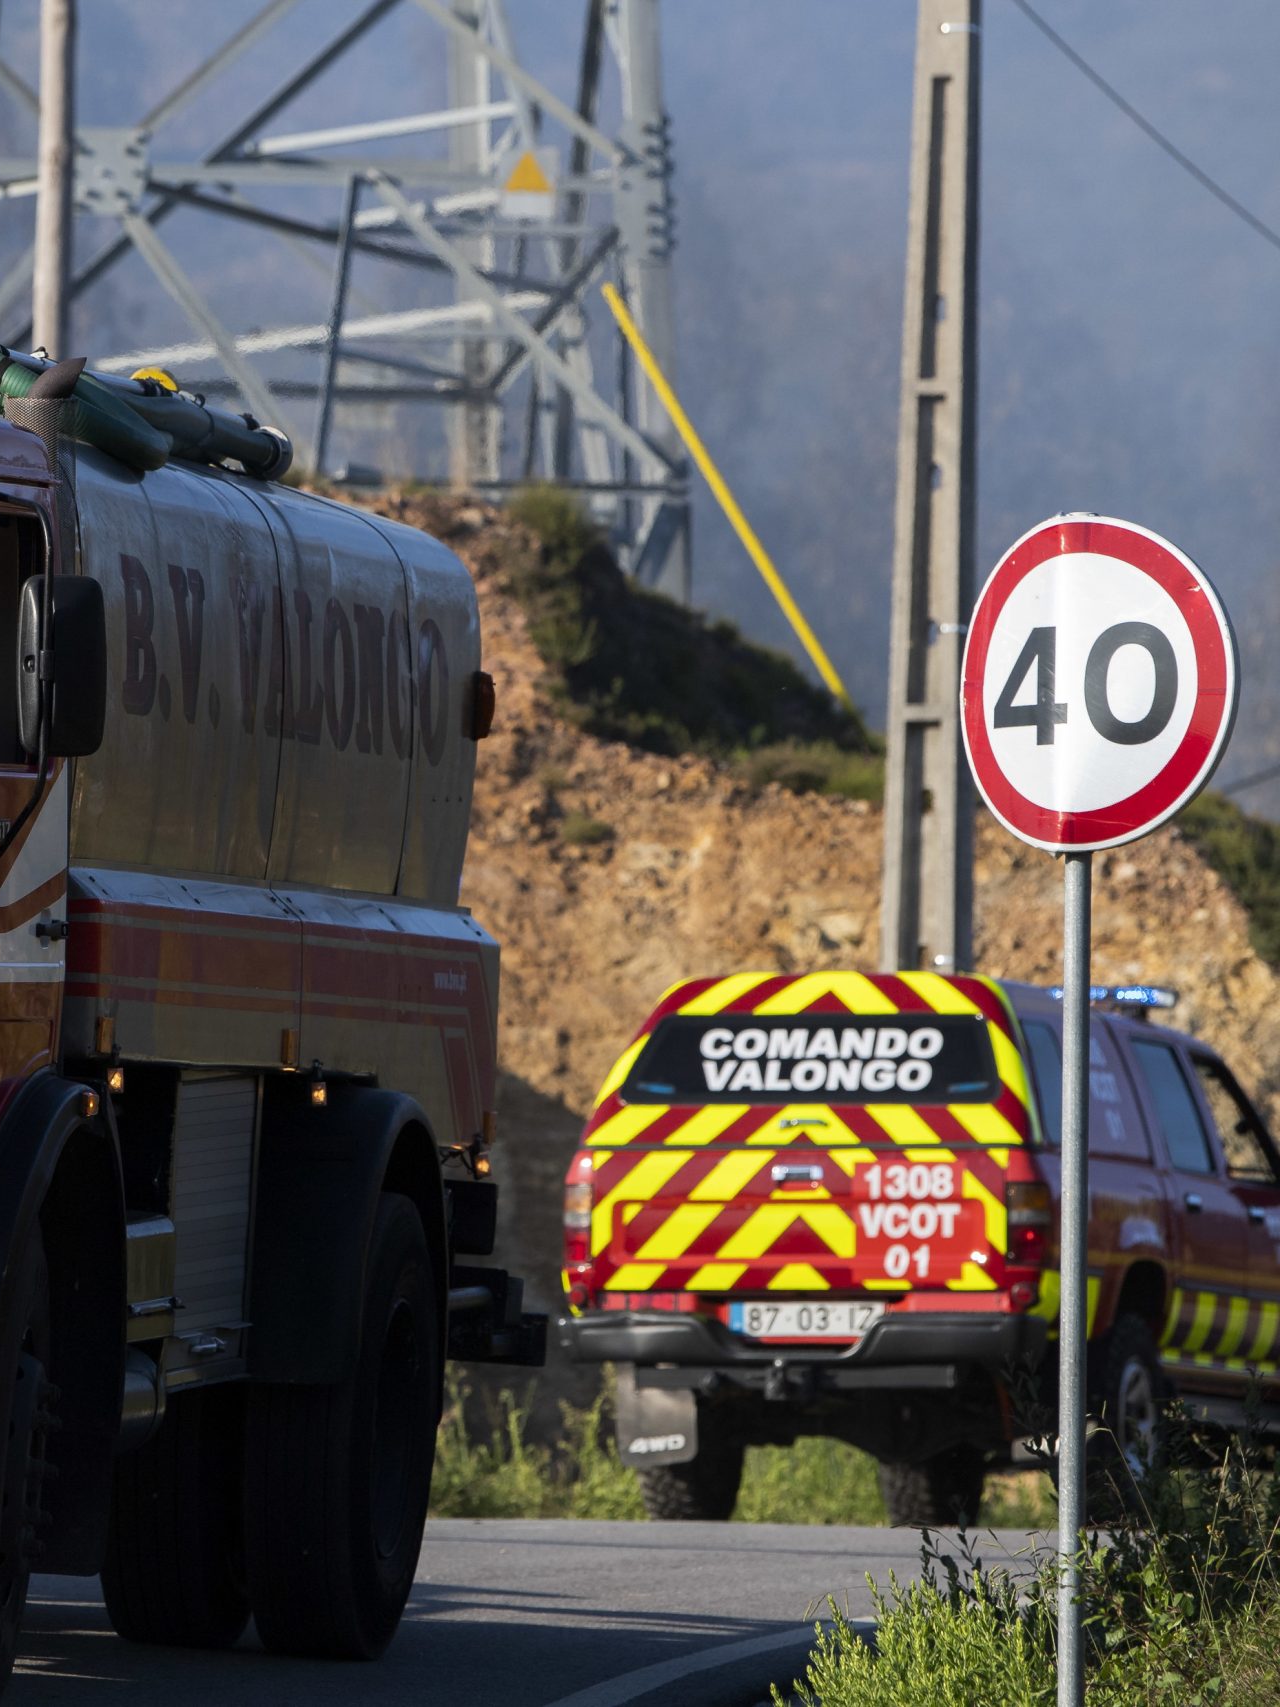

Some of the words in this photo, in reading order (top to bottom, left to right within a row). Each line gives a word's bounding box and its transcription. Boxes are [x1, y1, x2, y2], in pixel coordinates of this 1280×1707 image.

[993, 621, 1179, 746] 40
[699, 1027, 944, 1060] COMANDO
[701, 1058, 933, 1092] VALONGO
[863, 1164, 955, 1201] 1308
[858, 1202, 962, 1240] VCOT
[883, 1243, 931, 1279] 01
[628, 1433, 686, 1455] 4WD
